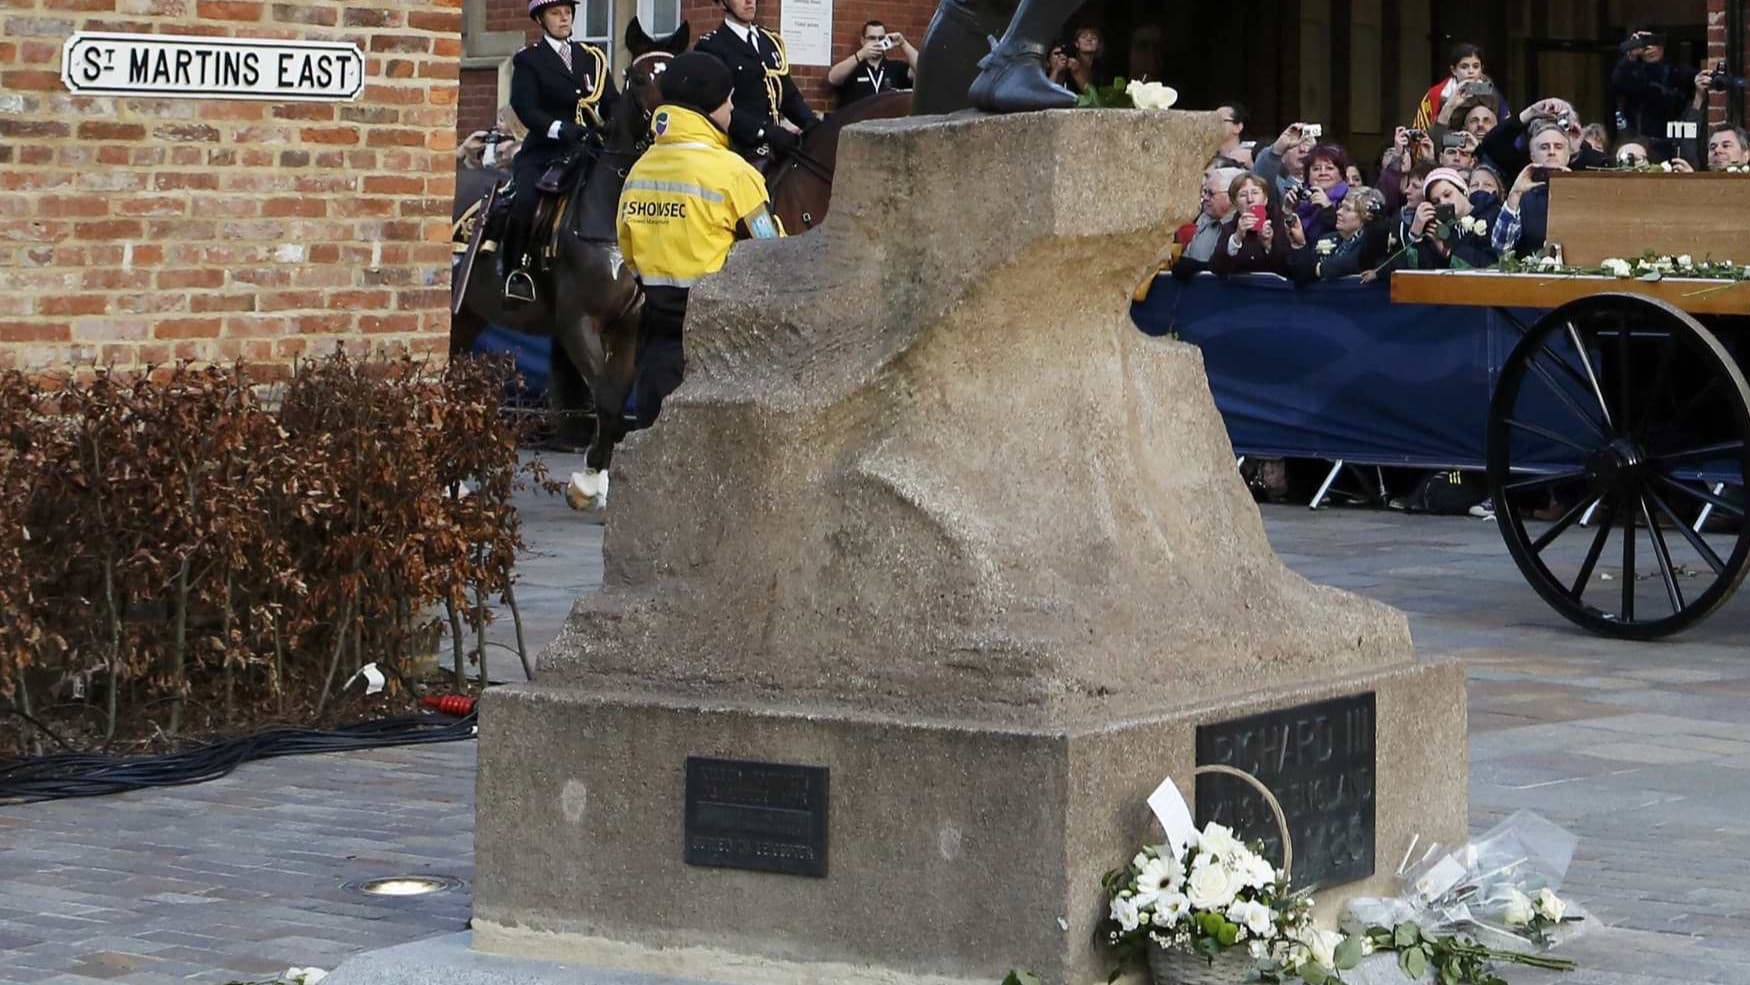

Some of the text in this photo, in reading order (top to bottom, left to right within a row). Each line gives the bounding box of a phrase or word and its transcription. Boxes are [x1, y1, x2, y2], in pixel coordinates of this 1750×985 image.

[129, 48, 260, 86] MARTINS
[277, 53, 352, 89] EAST
[628, 201, 686, 218] SHOWSEC
